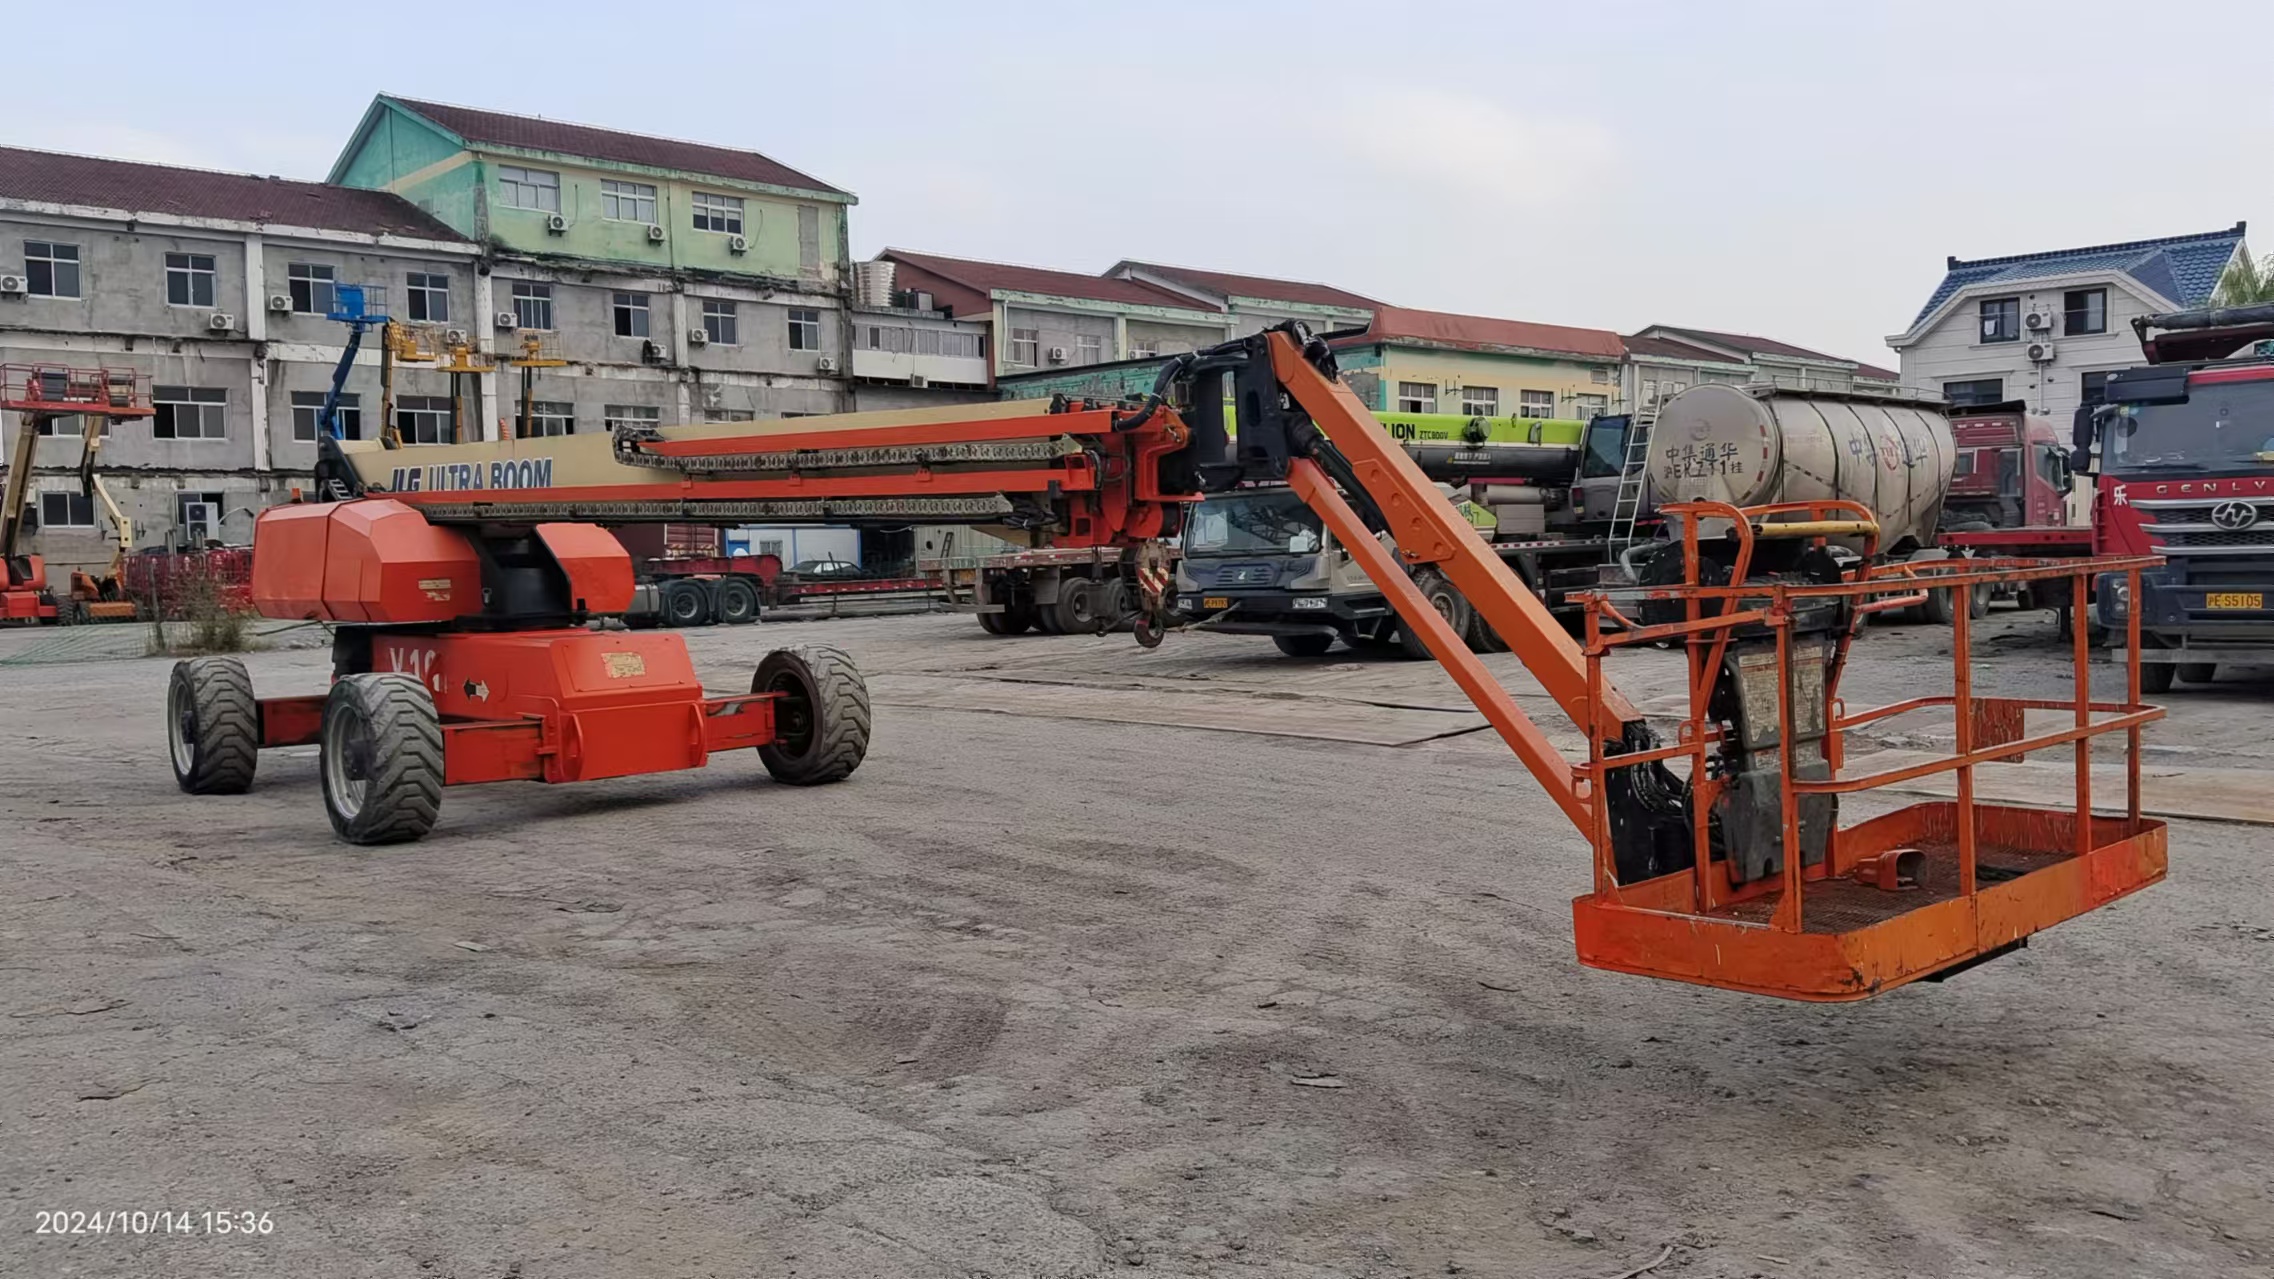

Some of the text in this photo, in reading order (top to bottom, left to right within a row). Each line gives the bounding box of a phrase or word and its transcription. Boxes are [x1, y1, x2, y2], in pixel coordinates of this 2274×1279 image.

[1665, 442, 1739, 464] 中集通华
[392, 457, 553, 492] JLG ULTRA BOOM
